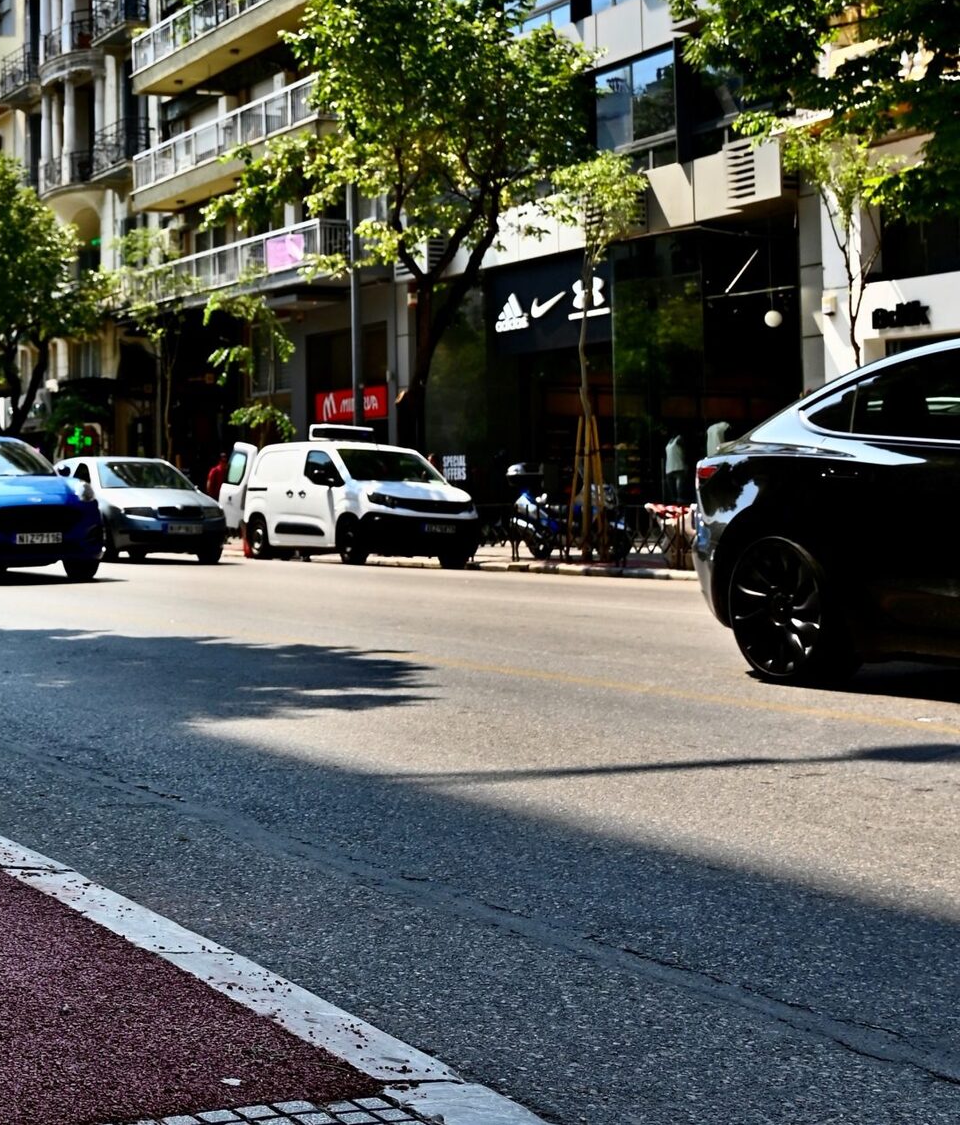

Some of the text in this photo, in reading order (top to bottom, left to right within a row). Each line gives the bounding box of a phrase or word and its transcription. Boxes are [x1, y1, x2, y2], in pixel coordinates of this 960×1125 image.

[340, 394, 379, 413] MINVA
[442, 455, 466, 467] SPECIAL
[442, 467, 467, 481] OFFERS
